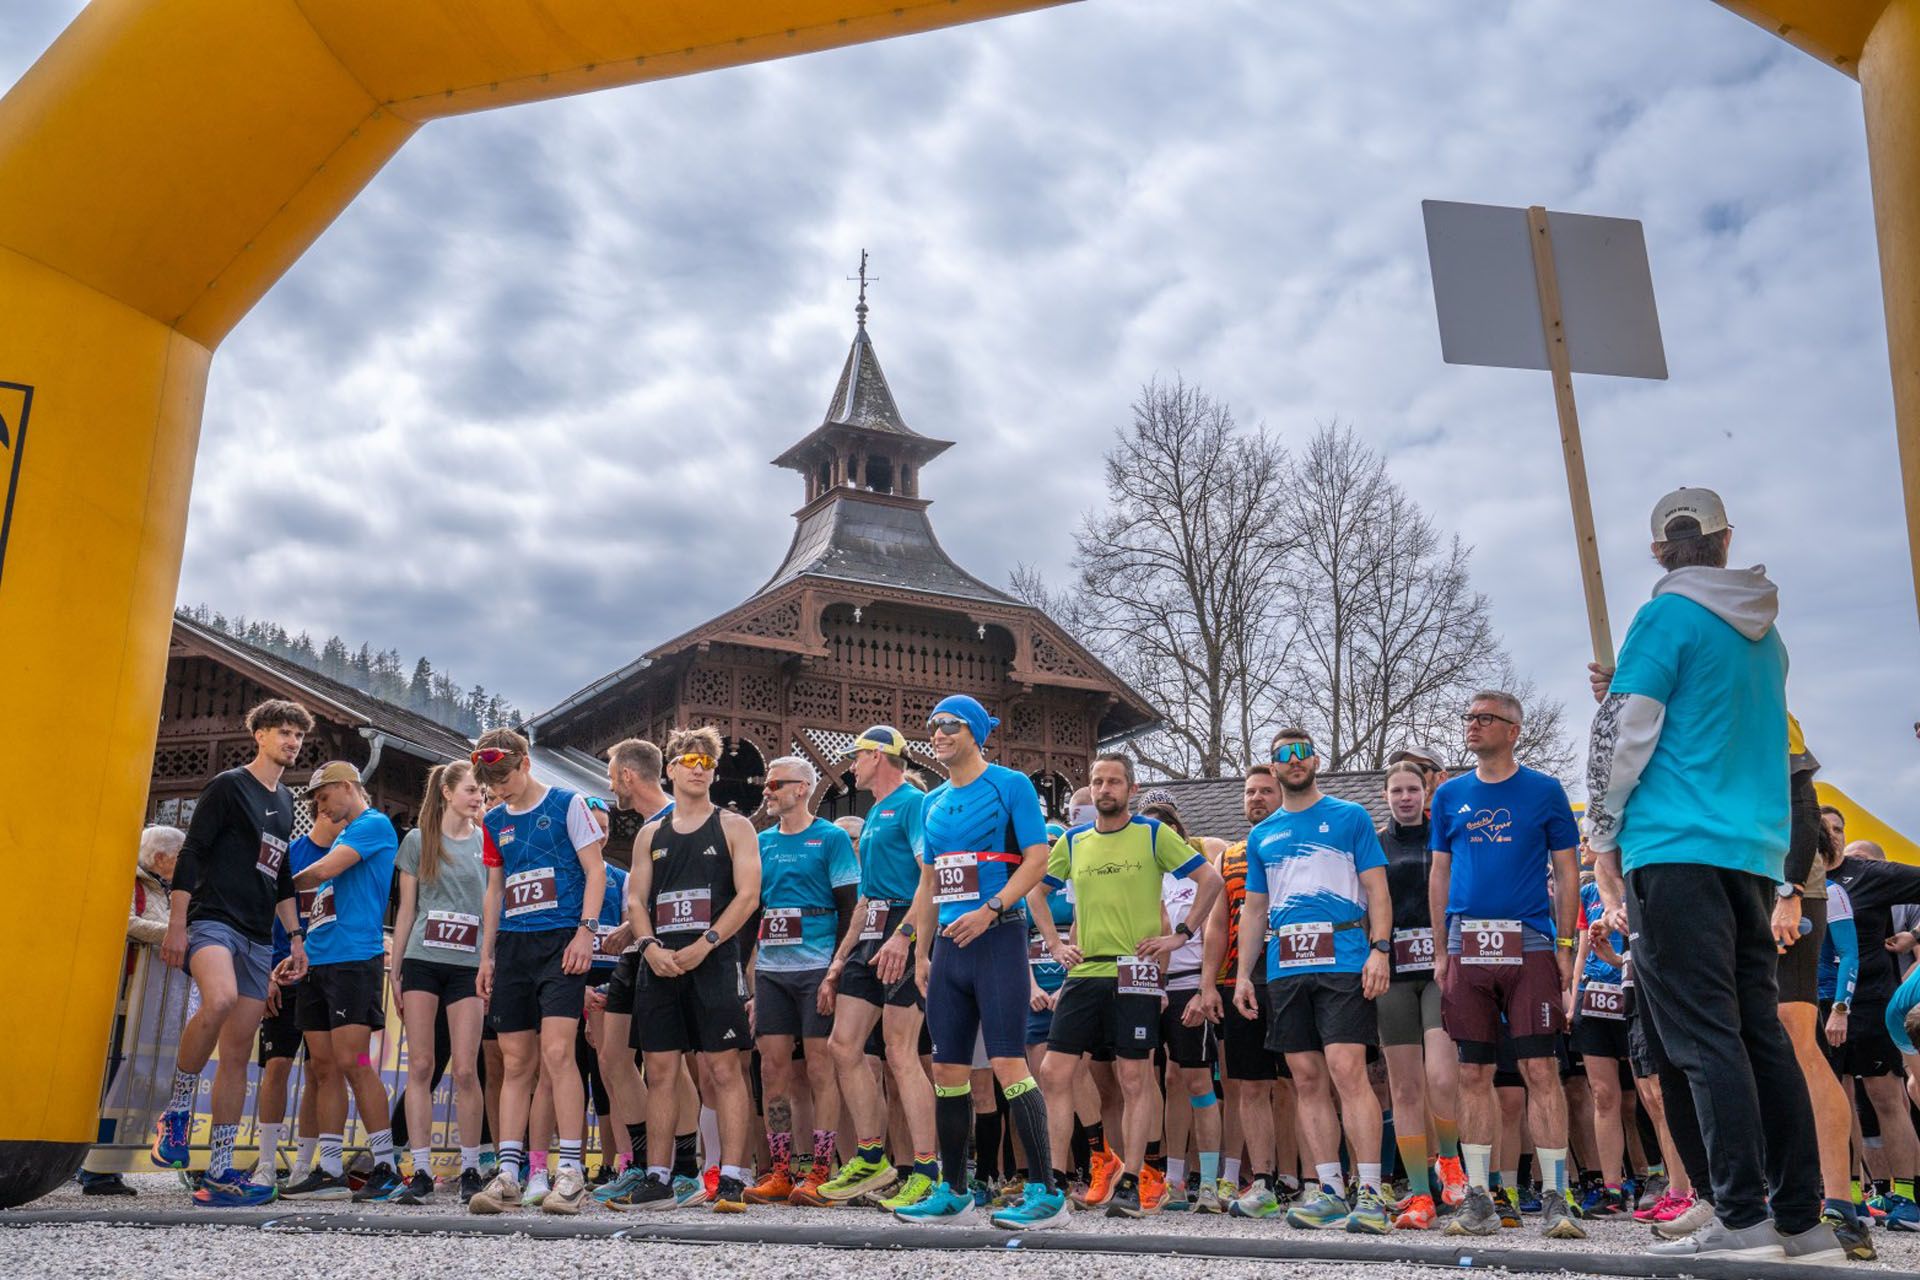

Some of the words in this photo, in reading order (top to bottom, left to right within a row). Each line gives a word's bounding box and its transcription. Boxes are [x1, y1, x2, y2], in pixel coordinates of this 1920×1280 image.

[267, 847, 282, 868] 72
[939, 867, 964, 886] 130
[512, 881, 544, 904] 173
[940, 886, 964, 894] Michael
[673, 900, 692, 917] 18
[438, 922, 468, 941] 177
[769, 917, 788, 933] 62
[1289, 933, 1320, 952] 127
[1408, 938, 1434, 956] 48
[1477, 932, 1504, 950] 90
[1295, 951, 1316, 959] Patrik
[1414, 955, 1432, 963] Luise
[1480, 949, 1503, 957] Daniel
[1129, 965, 1159, 982] 123
[1132, 979, 1159, 988] Christian
[1590, 992, 1618, 1010] 186
